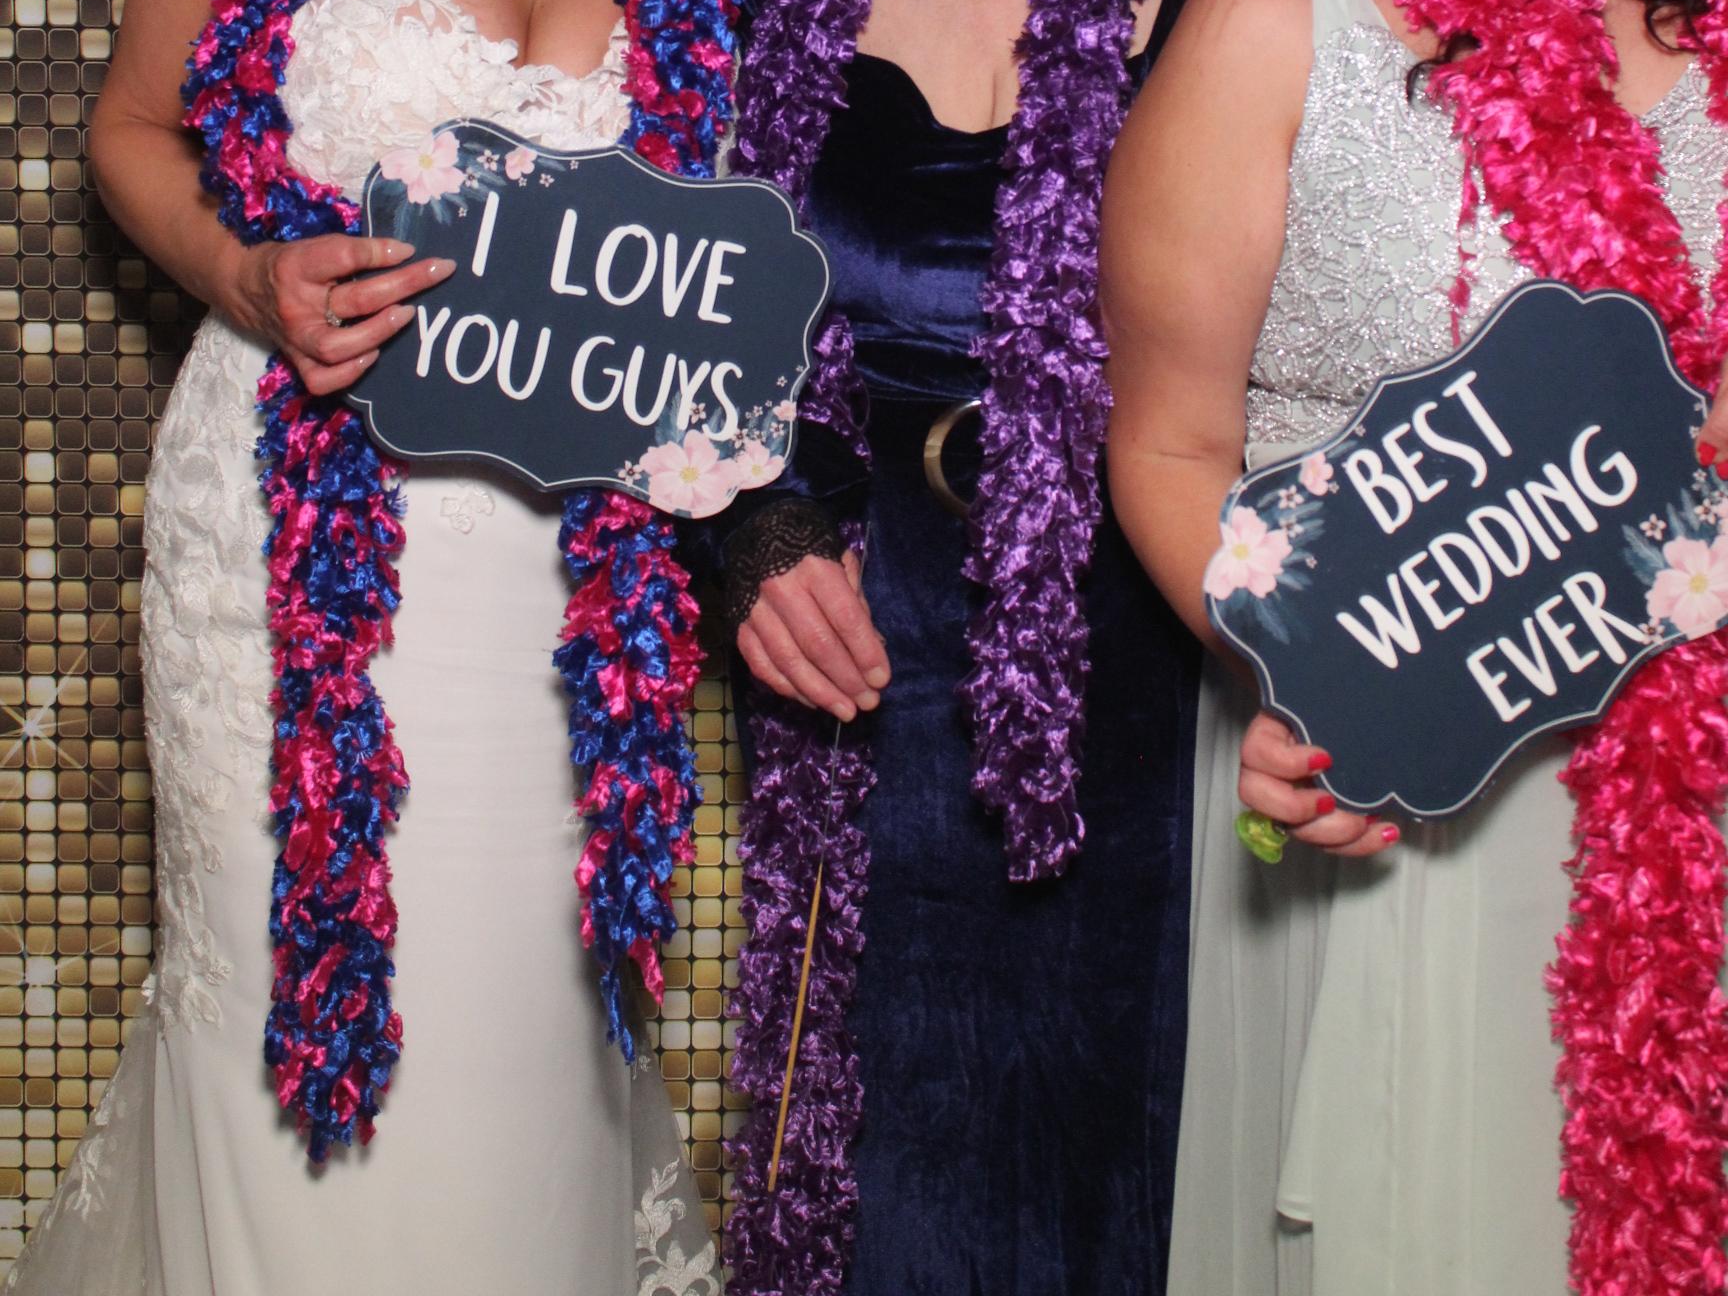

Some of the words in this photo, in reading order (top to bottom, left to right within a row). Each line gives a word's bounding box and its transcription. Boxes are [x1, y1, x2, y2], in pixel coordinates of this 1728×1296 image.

[472, 190, 499, 277] I
[550, 208, 746, 324] LOVE
[416, 304, 551, 400] YOU
[571, 336, 743, 442] GUYS
[1342, 370, 1513, 534] BEST
[1336, 424, 1638, 669] WEDDING
[1466, 571, 1646, 722] EVER
